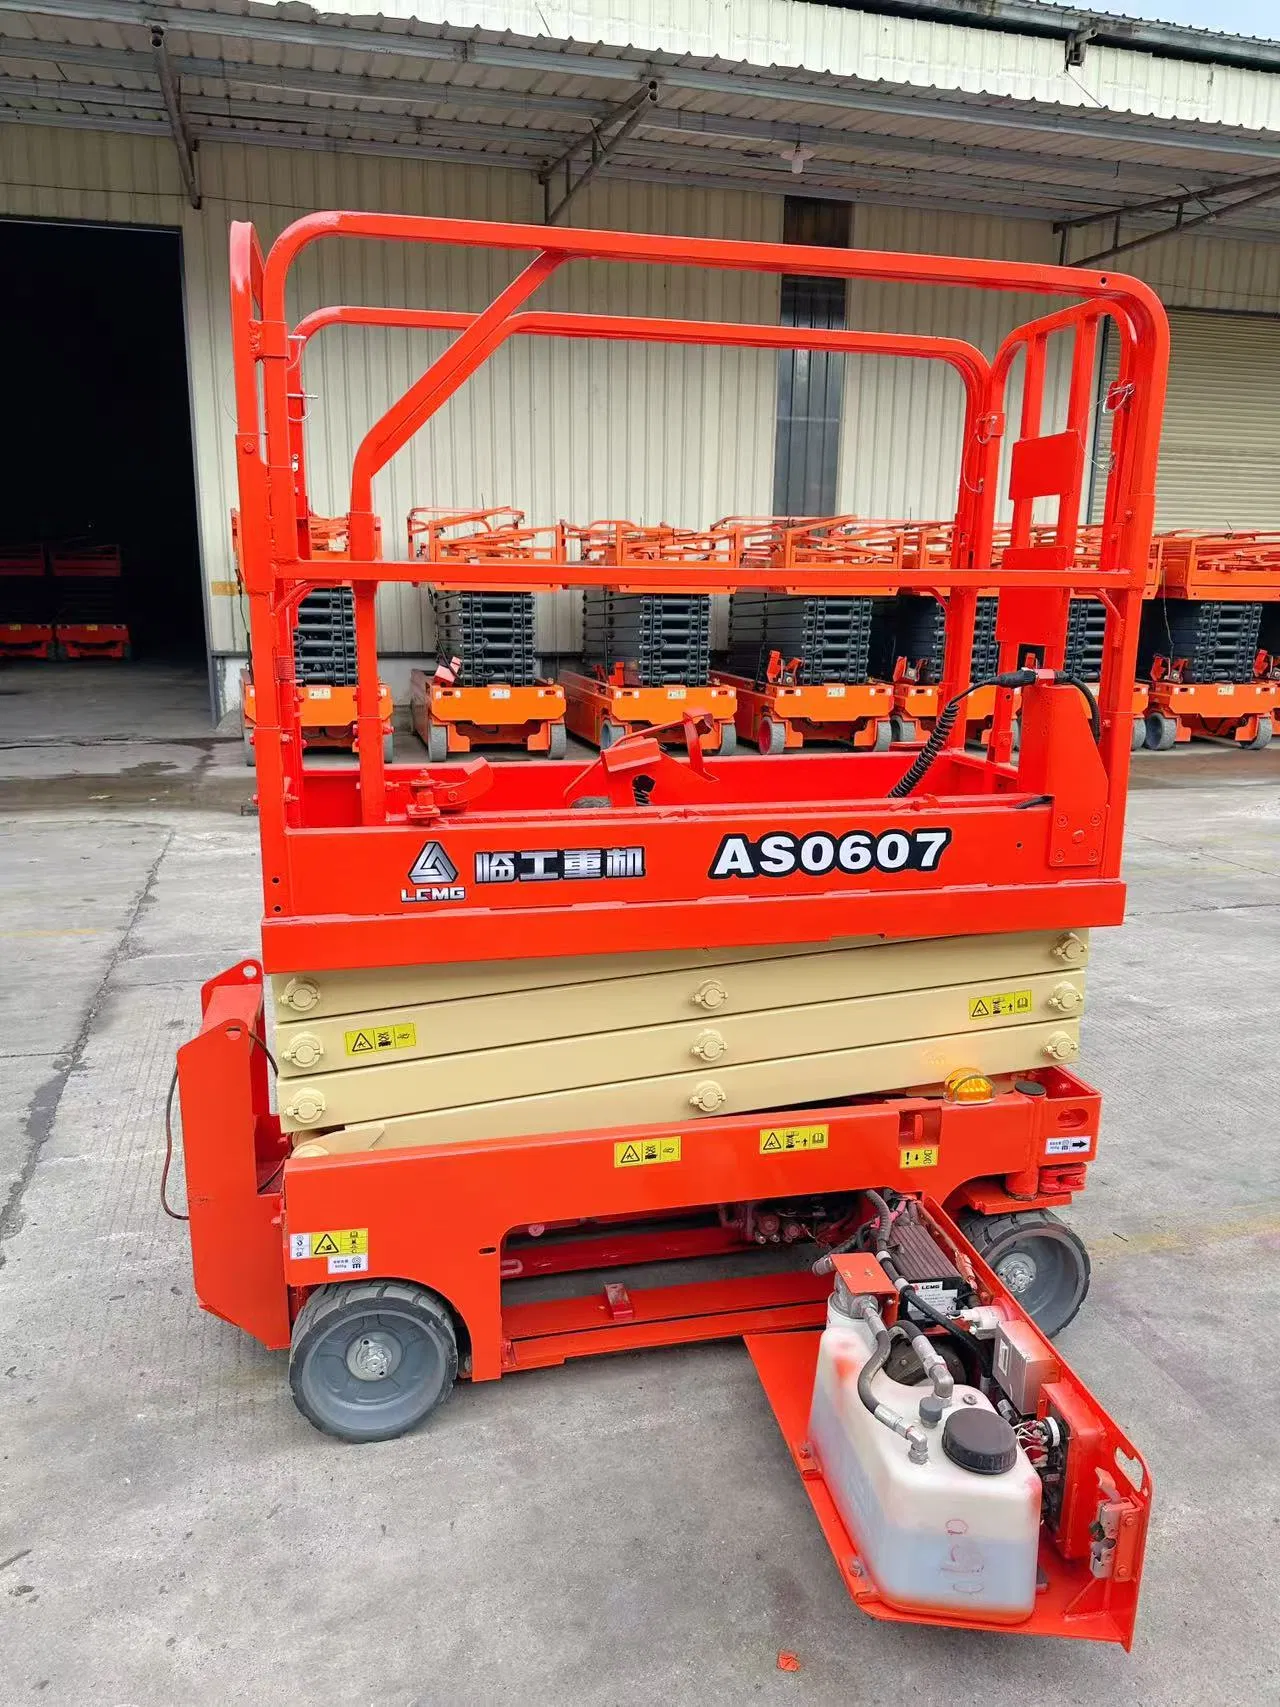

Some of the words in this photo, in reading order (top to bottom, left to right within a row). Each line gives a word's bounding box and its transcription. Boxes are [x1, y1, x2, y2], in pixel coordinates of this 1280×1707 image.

[476, 848, 645, 883] 临工重机
[710, 829, 950, 877] AS0607
